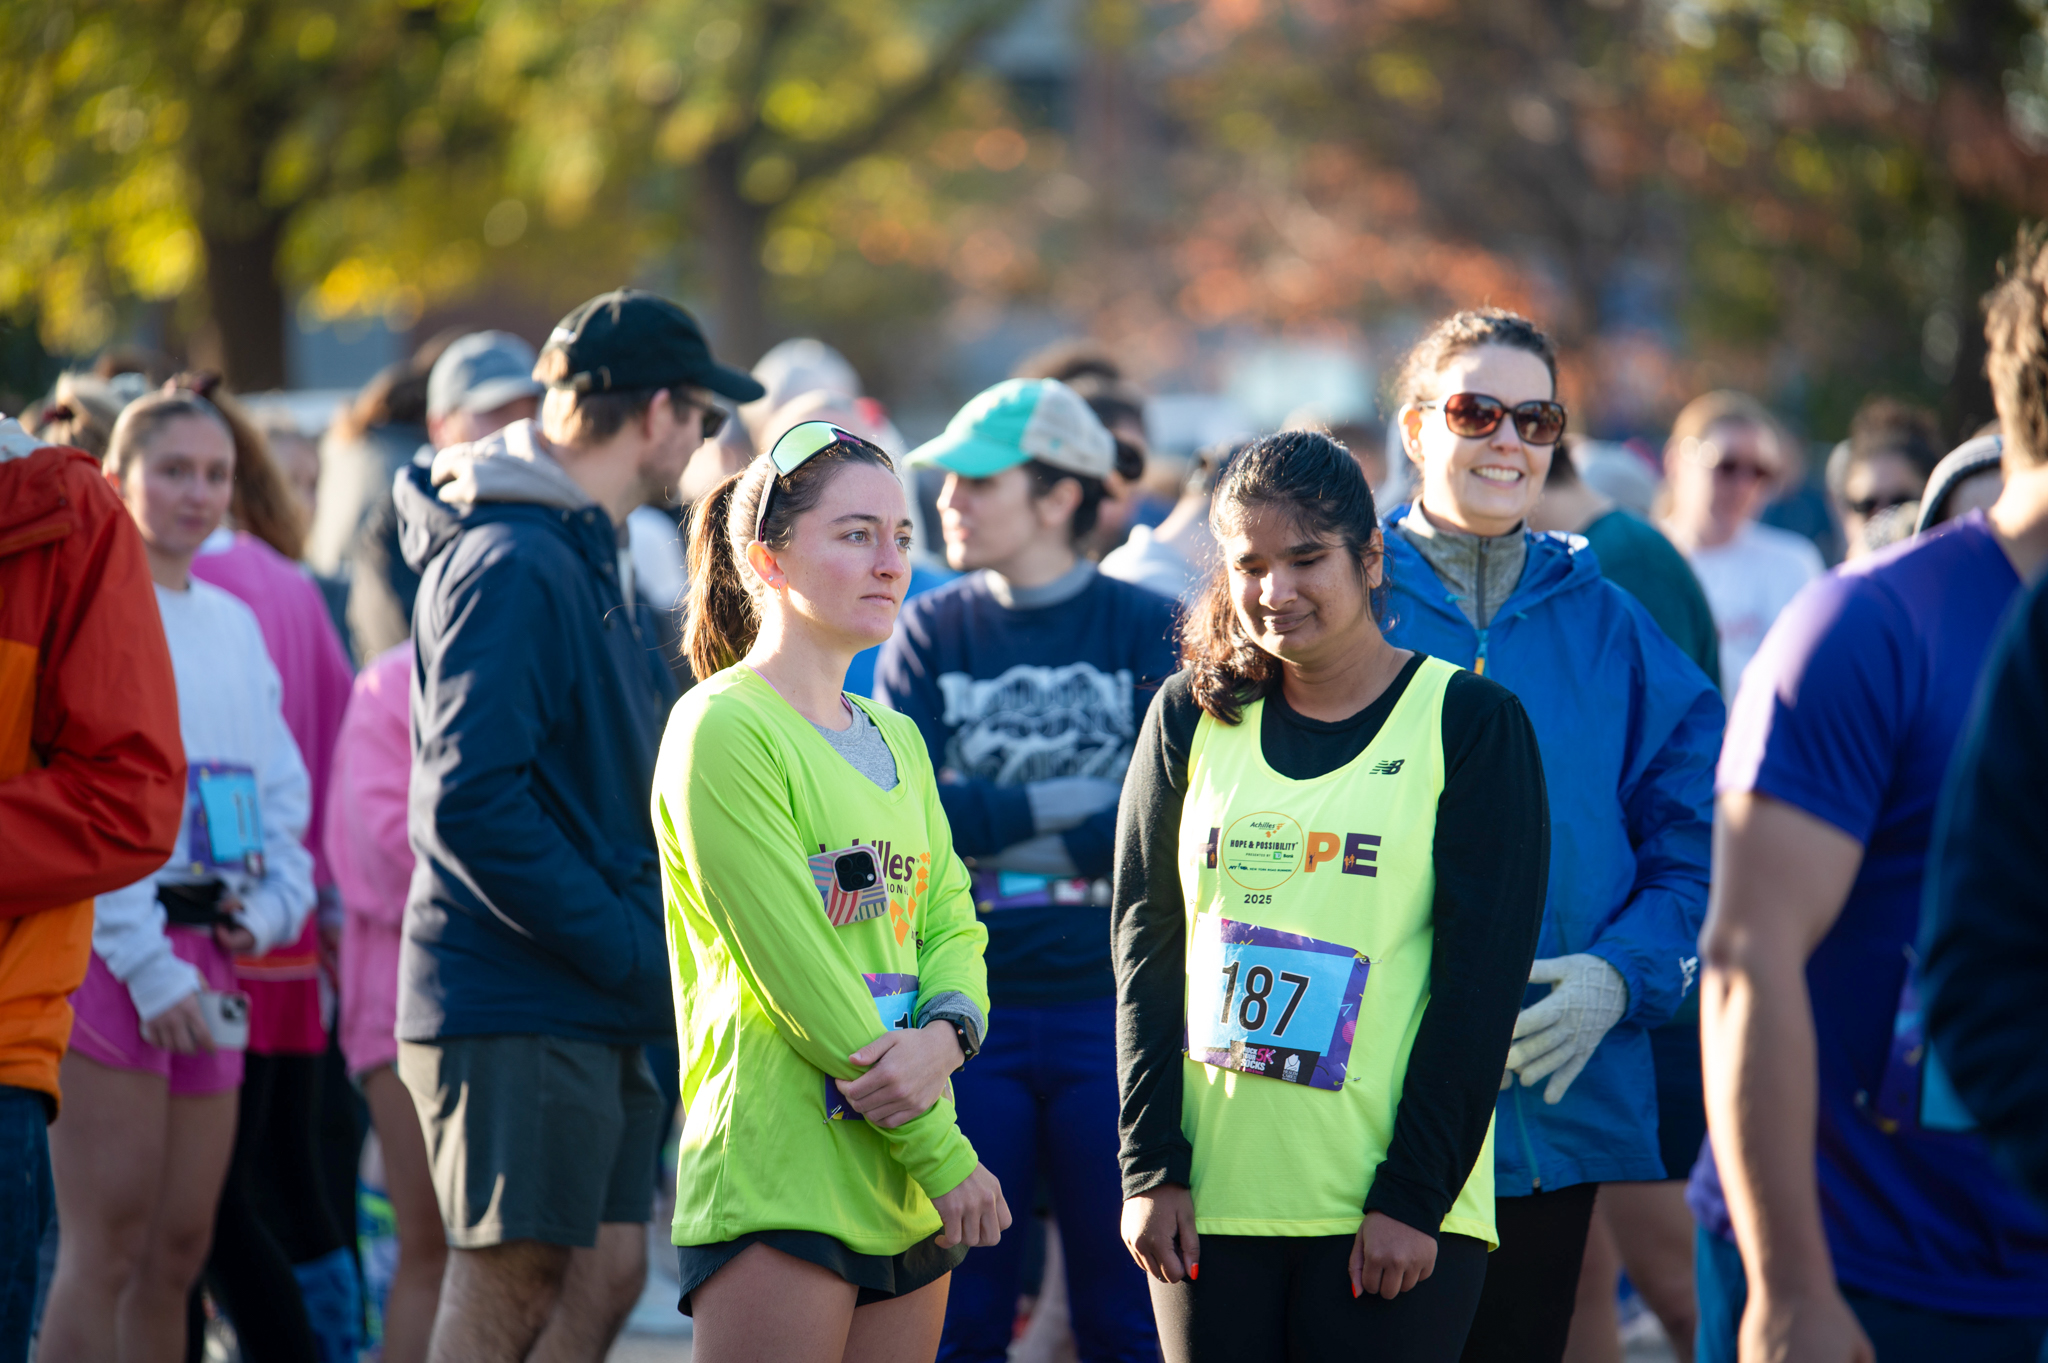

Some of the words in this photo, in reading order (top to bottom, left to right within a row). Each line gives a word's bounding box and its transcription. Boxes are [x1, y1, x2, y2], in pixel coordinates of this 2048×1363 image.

[1230, 840, 1247, 848] HOPE
[1256, 841, 1296, 850] POSSIBILITY
[1244, 894, 1272, 904] 2025
[1220, 960, 1311, 1038] 187
[1256, 1048, 1276, 1064] 5K
[1241, 1058, 1266, 1071] SOCKS
